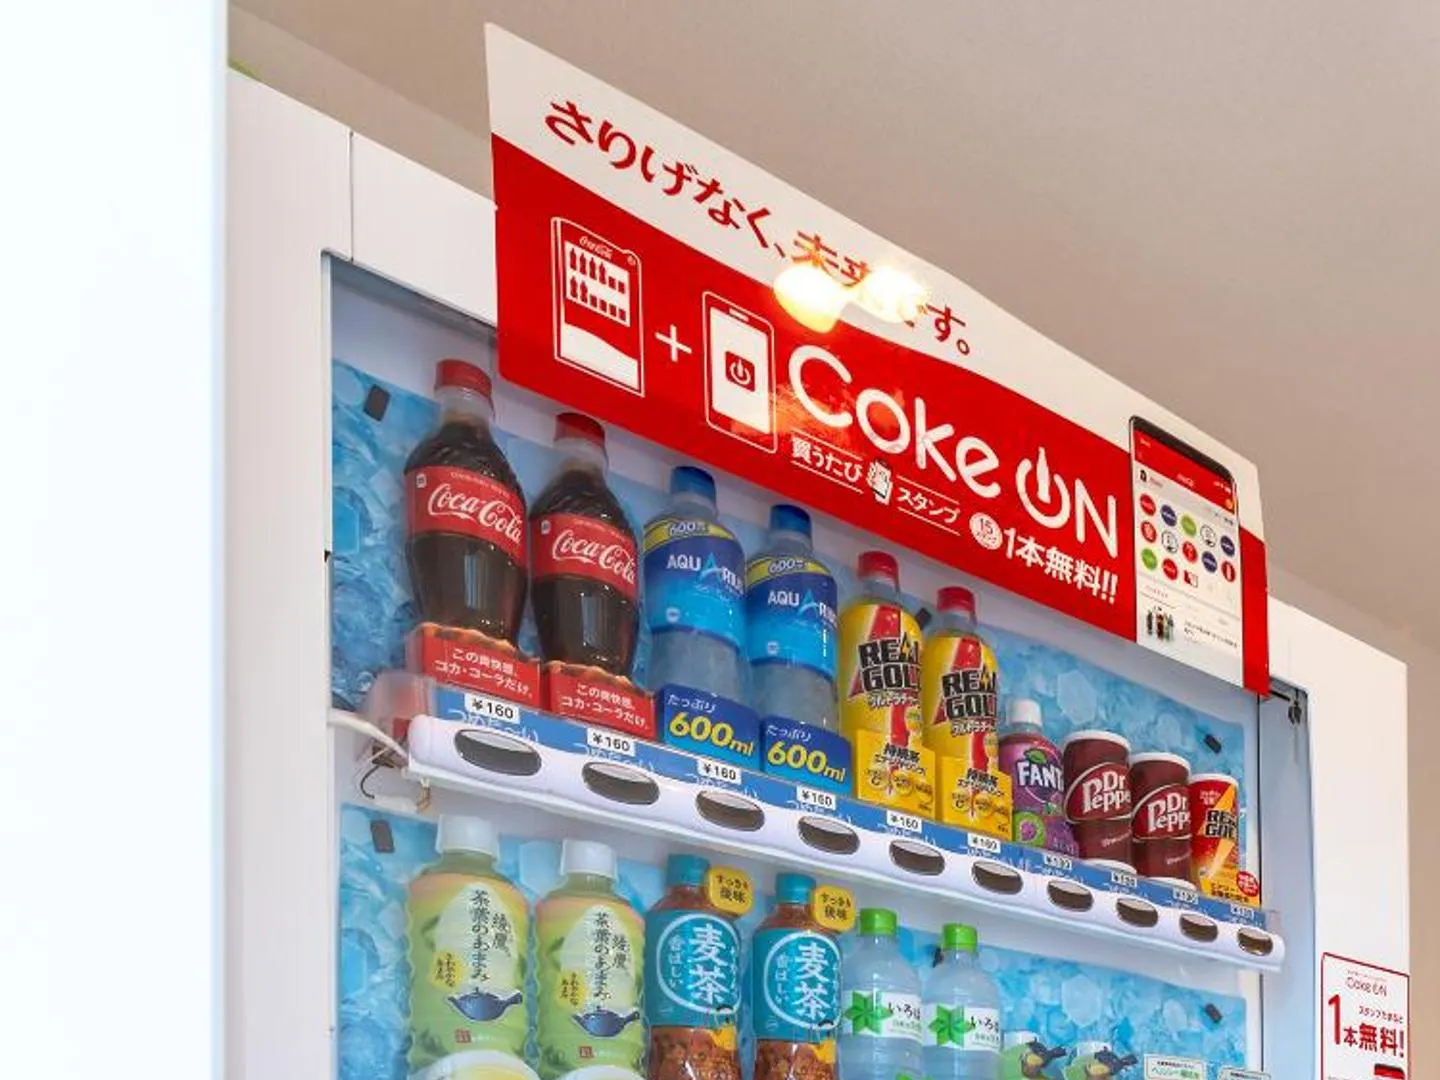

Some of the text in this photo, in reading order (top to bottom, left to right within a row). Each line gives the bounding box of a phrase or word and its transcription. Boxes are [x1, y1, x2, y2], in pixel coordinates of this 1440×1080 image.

[787, 344, 1119, 558] Coke ON
[791, 436, 864, 484] 買うたび
[428, 483, 523, 545] Coca-Cola
[897, 486, 962, 524] スタンプ
[552, 529, 637, 585] Coca-Cola
[689, 922, 730, 1006] 麦茶
[793, 941, 832, 1021] 麦茶
